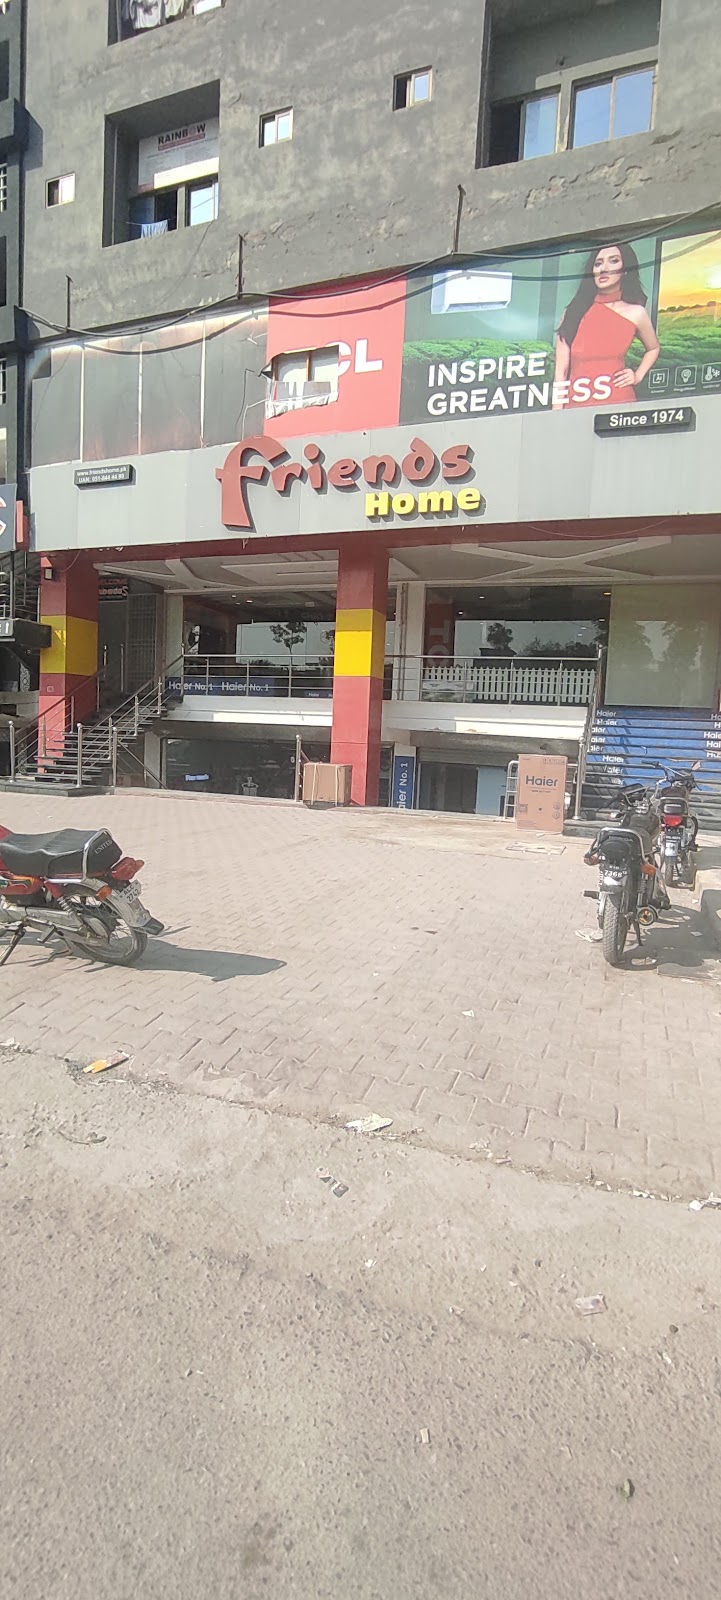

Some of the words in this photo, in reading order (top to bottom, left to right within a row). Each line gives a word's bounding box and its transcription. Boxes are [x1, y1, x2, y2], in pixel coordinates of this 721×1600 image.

[158, 123, 206, 145] RAINBOW
[428, 352, 547, 387] INSPIRE
[427, 375, 613, 416] GREATNESS
[609, 413, 647, 428] Since
[651, 409, 684, 425] 1974
[364, 487, 481, 518] Home
[168, 681, 192, 690] Haer
[221, 681, 247, 691] Haier
[264, 683, 269, 692] 1
[596, 709, 616, 717] Haier
[399, 770, 408, 786] No.
[525, 774, 558, 787] Haier
[396, 789, 407, 809] aier
[94, 839, 113, 855] UNITED
